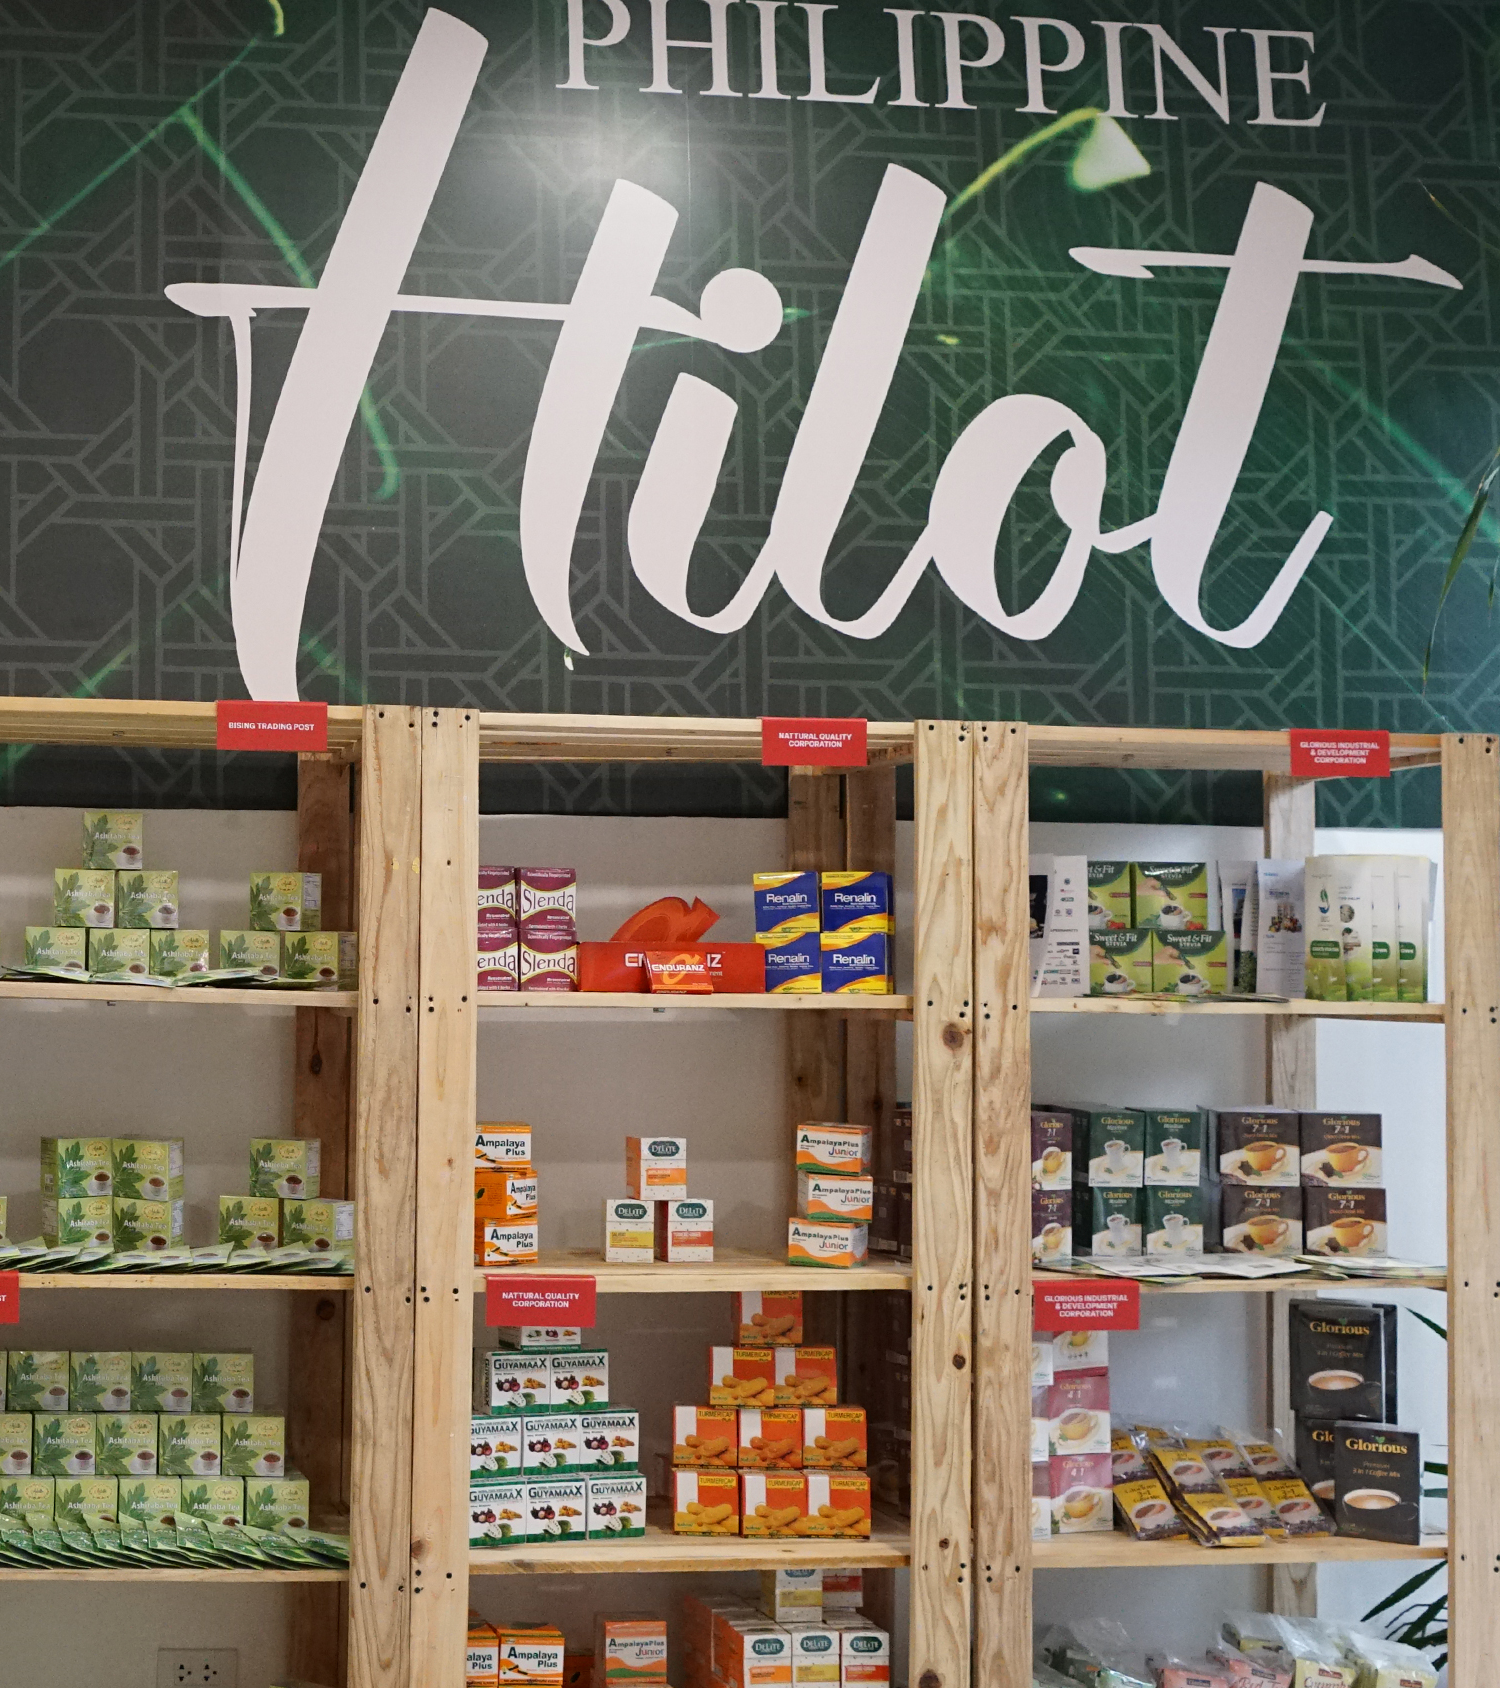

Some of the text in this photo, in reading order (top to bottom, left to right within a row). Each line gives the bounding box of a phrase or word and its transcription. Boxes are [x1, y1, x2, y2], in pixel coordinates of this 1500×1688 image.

[556, 0, 1326, 128] PHILIPPINE
[163, 6, 1465, 703] Hilot
[228, 722, 314, 731] BISING TRADING POST
[818, 733, 852, 742] QUALITY
[788, 740, 842, 748] CORPORATION
[1300, 741, 1379, 750] GLORIOUS INDUSTRIAL
[1316, 749, 1369, 757] DEVELOPMENT
[1314, 756, 1366, 764] CORPORATION
[522, 888, 575, 914] Slenda
[766, 893, 807, 904] Renalin
[834, 893, 876, 903] Renalin
[521, 951, 576, 976] Slenda
[768, 953, 809, 964] Renalin
[832, 954, 875, 965] Renalin
[651, 963, 705, 973] ENDURANZ
[1241, 1117, 1278, 1125] Glorious
[475, 1134, 526, 1149] Ampalaya
[505, 1148, 526, 1156] Plus
[828, 1147, 858, 1157] Junior
[510, 1182, 536, 1194] Ampalaya
[841, 1194, 870, 1204] Junior
[1244, 1191, 1281, 1199] Glorious
[490, 1228, 534, 1241] Ampalaya
[516, 1240, 534, 1248] Plus
[819, 1240, 848, 1250] Junior
[502, 1292, 580, 1301] NATTURAL QUALITY
[1044, 1294, 1128, 1302] GLORIOUS INDUSTRIAL
[512, 1300, 569, 1308] CORPORATION
[1055, 1302, 1118, 1310] & DEVELOPMENT
[1059, 1309, 1113, 1317] CORPORATION
[1309, 1320, 1370, 1336] Glorious
[1345, 1437, 1408, 1455] Glorious
[507, 1646, 558, 1661] Ampalaya
[636, 1646, 664, 1657] Junior
[537, 1660, 558, 1669] Plus
